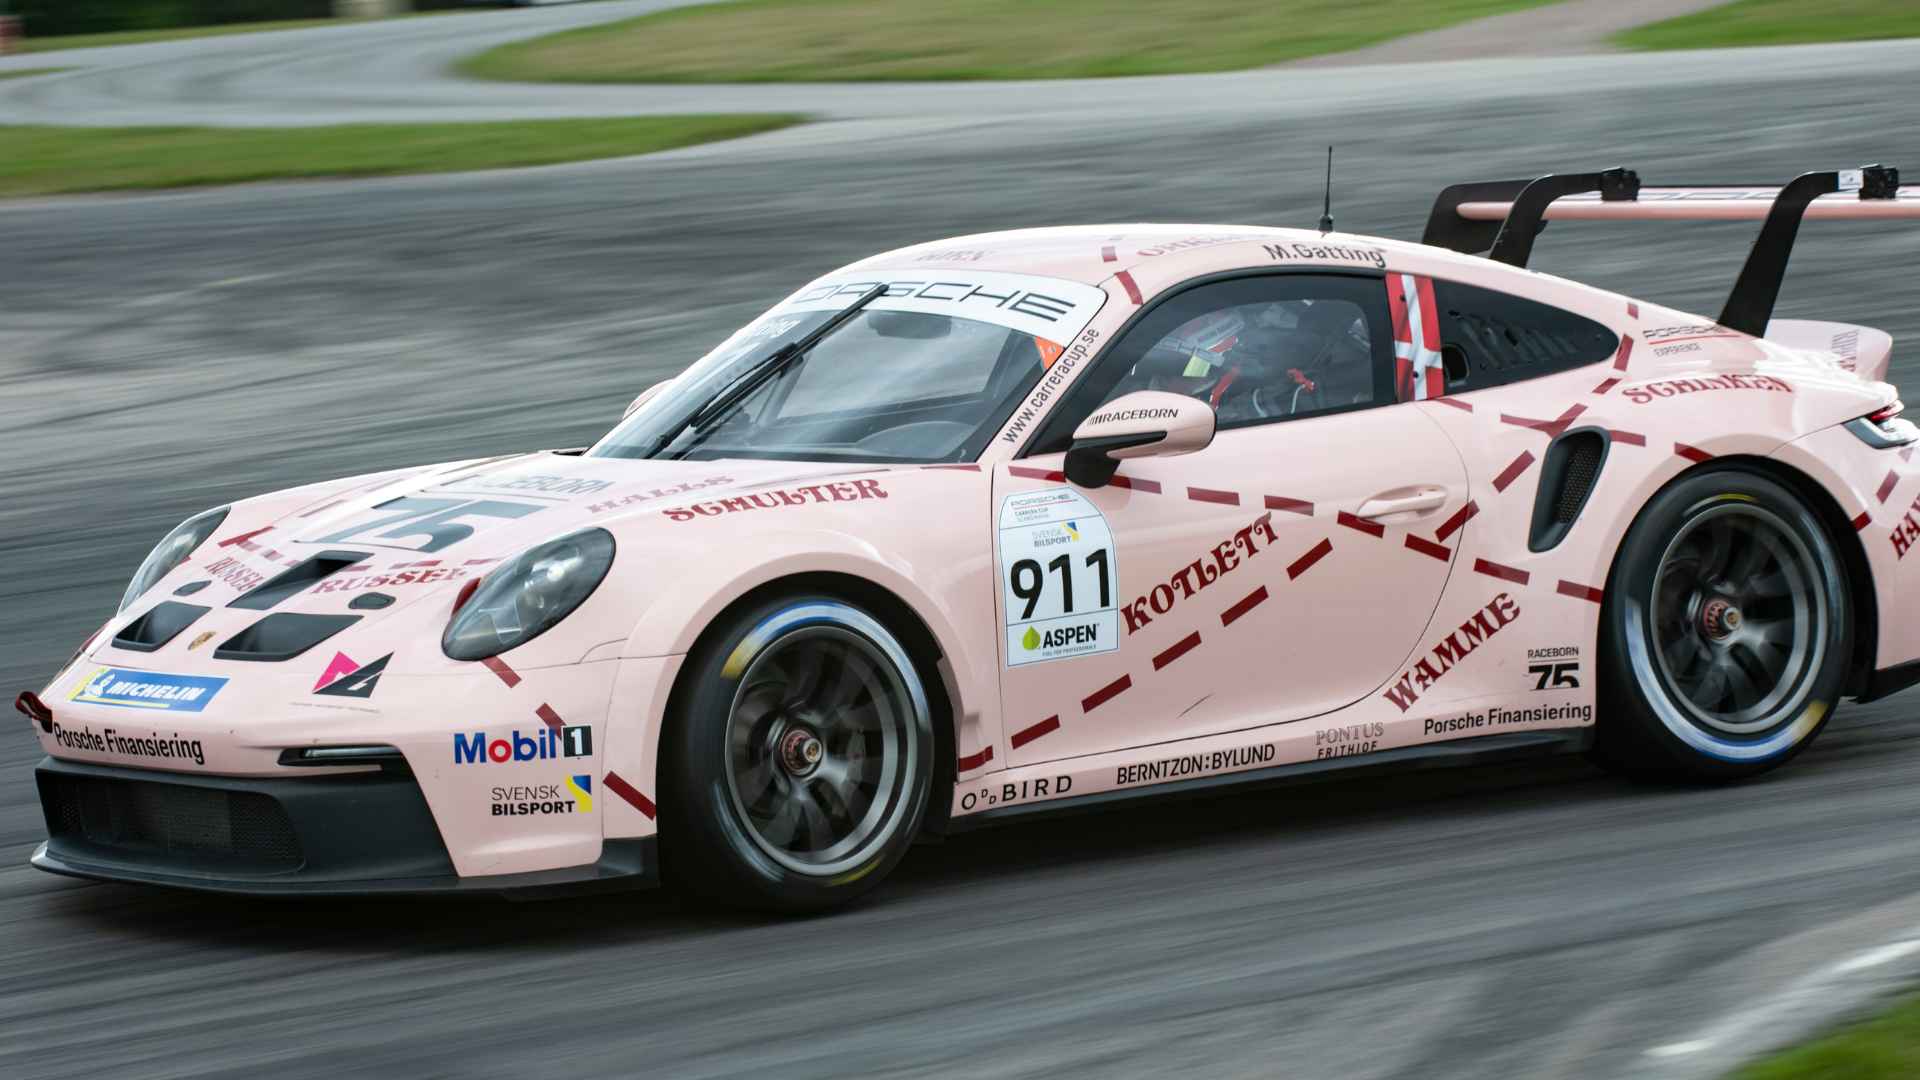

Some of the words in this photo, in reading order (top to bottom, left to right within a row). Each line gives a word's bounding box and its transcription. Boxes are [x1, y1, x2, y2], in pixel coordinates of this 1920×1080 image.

[1262, 243, 1387, 268] M.Gatting
[793, 281, 1076, 323] ORSCHE
[1002, 327, 1100, 444] www.carreracup.se
[1622, 374, 1794, 404] SCHINKEN
[1102, 408, 1179, 425] RACEBORN
[662, 478, 889, 522] SCHULTER
[1010, 548, 1110, 620] 911
[1121, 511, 1279, 636] KOTLETT
[1042, 623, 1097, 649] ASPEN
[1383, 592, 1521, 713] WAMME
[1528, 646, 1580, 659] RACEBORN
[106, 681, 207, 701] MICHELIN
[1528, 662, 1580, 690] 75
[1315, 721, 1384, 746] PONTUS
[1424, 714, 1485, 736] Porsche
[1488, 703, 1593, 726] Finansiering
[53, 721, 104, 752] Porsche
[104, 727, 206, 765] Finansiering
[453, 728, 557, 764] Mobil
[568, 727, 586, 757] 1
[1116, 743, 1276, 785] BERNTZON:BYLUND
[491, 785, 560, 801] SVENSK
[491, 800, 575, 816] BILSPORT
